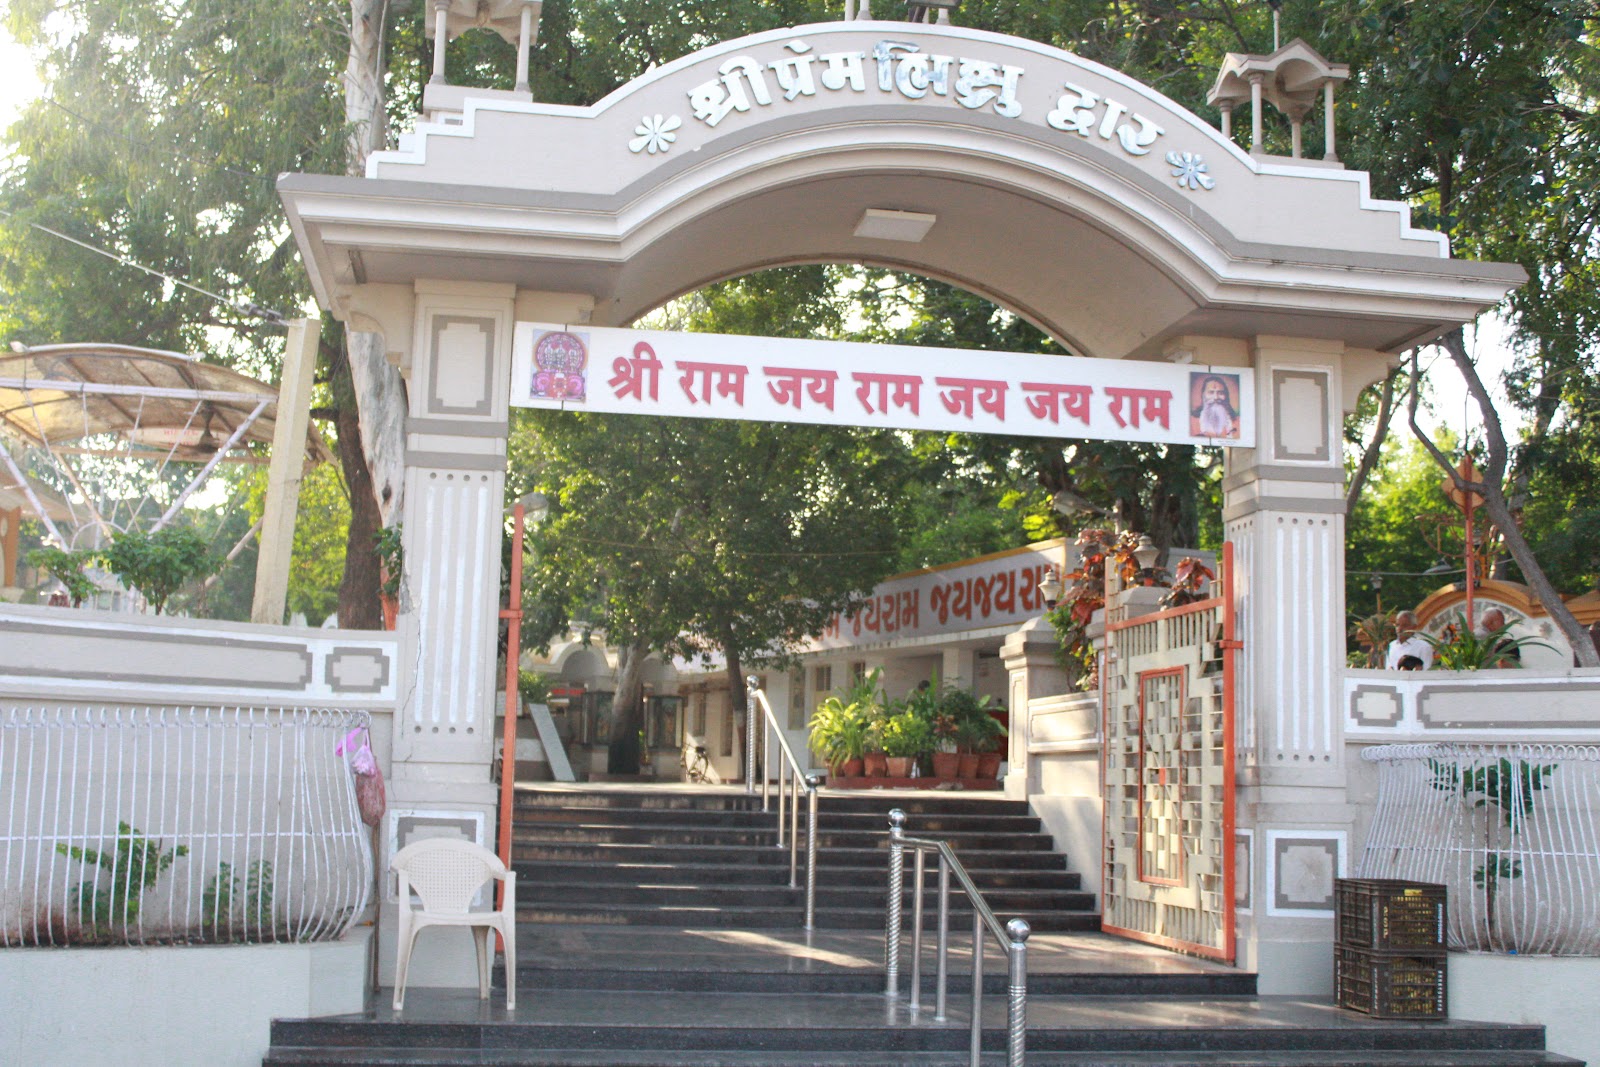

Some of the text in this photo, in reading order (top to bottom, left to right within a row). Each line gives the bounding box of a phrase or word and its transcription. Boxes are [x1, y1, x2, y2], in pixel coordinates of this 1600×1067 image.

[1046, 80, 1166, 156] द्वार
[607, 341, 1174, 431] श्री राम जय राम जय जय राम
